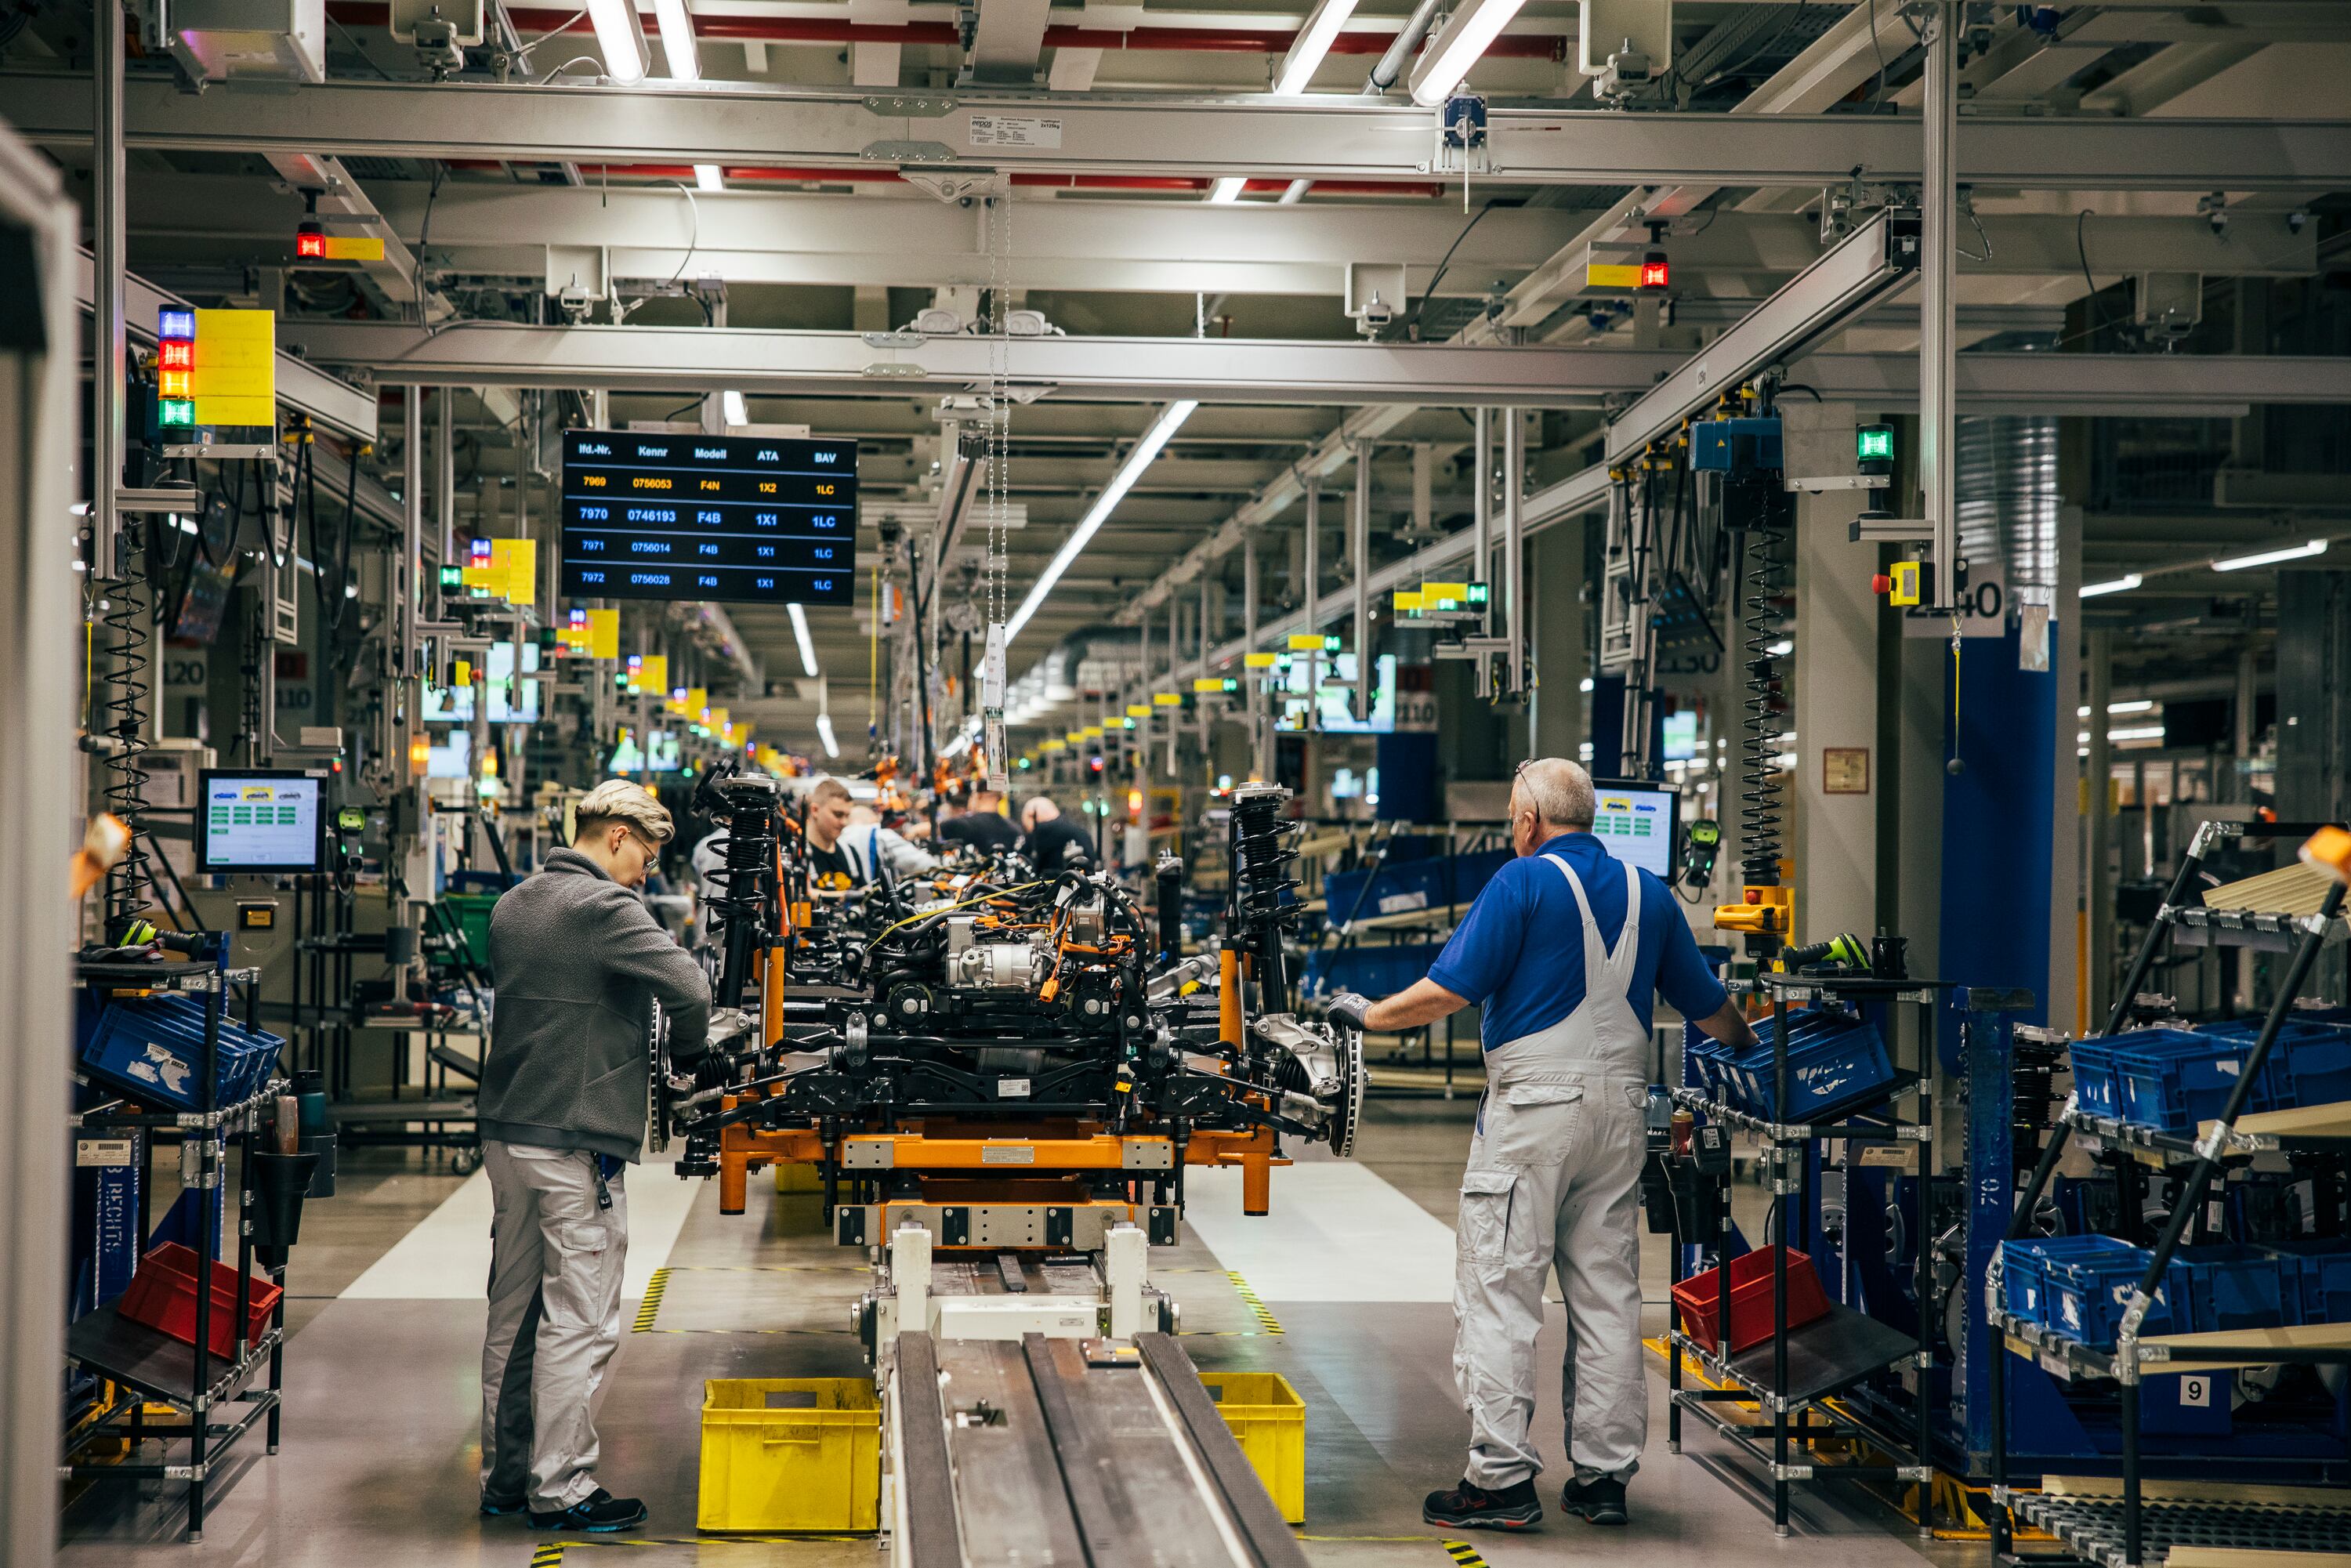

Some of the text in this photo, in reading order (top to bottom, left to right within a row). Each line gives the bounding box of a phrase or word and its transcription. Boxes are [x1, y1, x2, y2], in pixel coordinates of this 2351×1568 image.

[638, 445, 668, 458] Kennr
[694, 447, 727, 459] Modell
[756, 450, 780, 462] ATA
[813, 452, 837, 464] BAV
[583, 476, 835, 495] 7969 0756053 F4N 1X2 1LC
[579, 506, 836, 528] 7970 0746193 F4B 1X1 1LC
[581, 539, 833, 559] 7971 0756014 F4B 1X1 1LC
[581, 571, 832, 591] 7972 0756028 F4B 1X1 1LC
[1906, 581, 2002, 618] 40
[1396, 702, 1434, 722] 110
[1980, 1179, 2000, 1205] 70
[105, 1182, 124, 1253] RECHTS
[2188, 1381, 2202, 1400] 9
